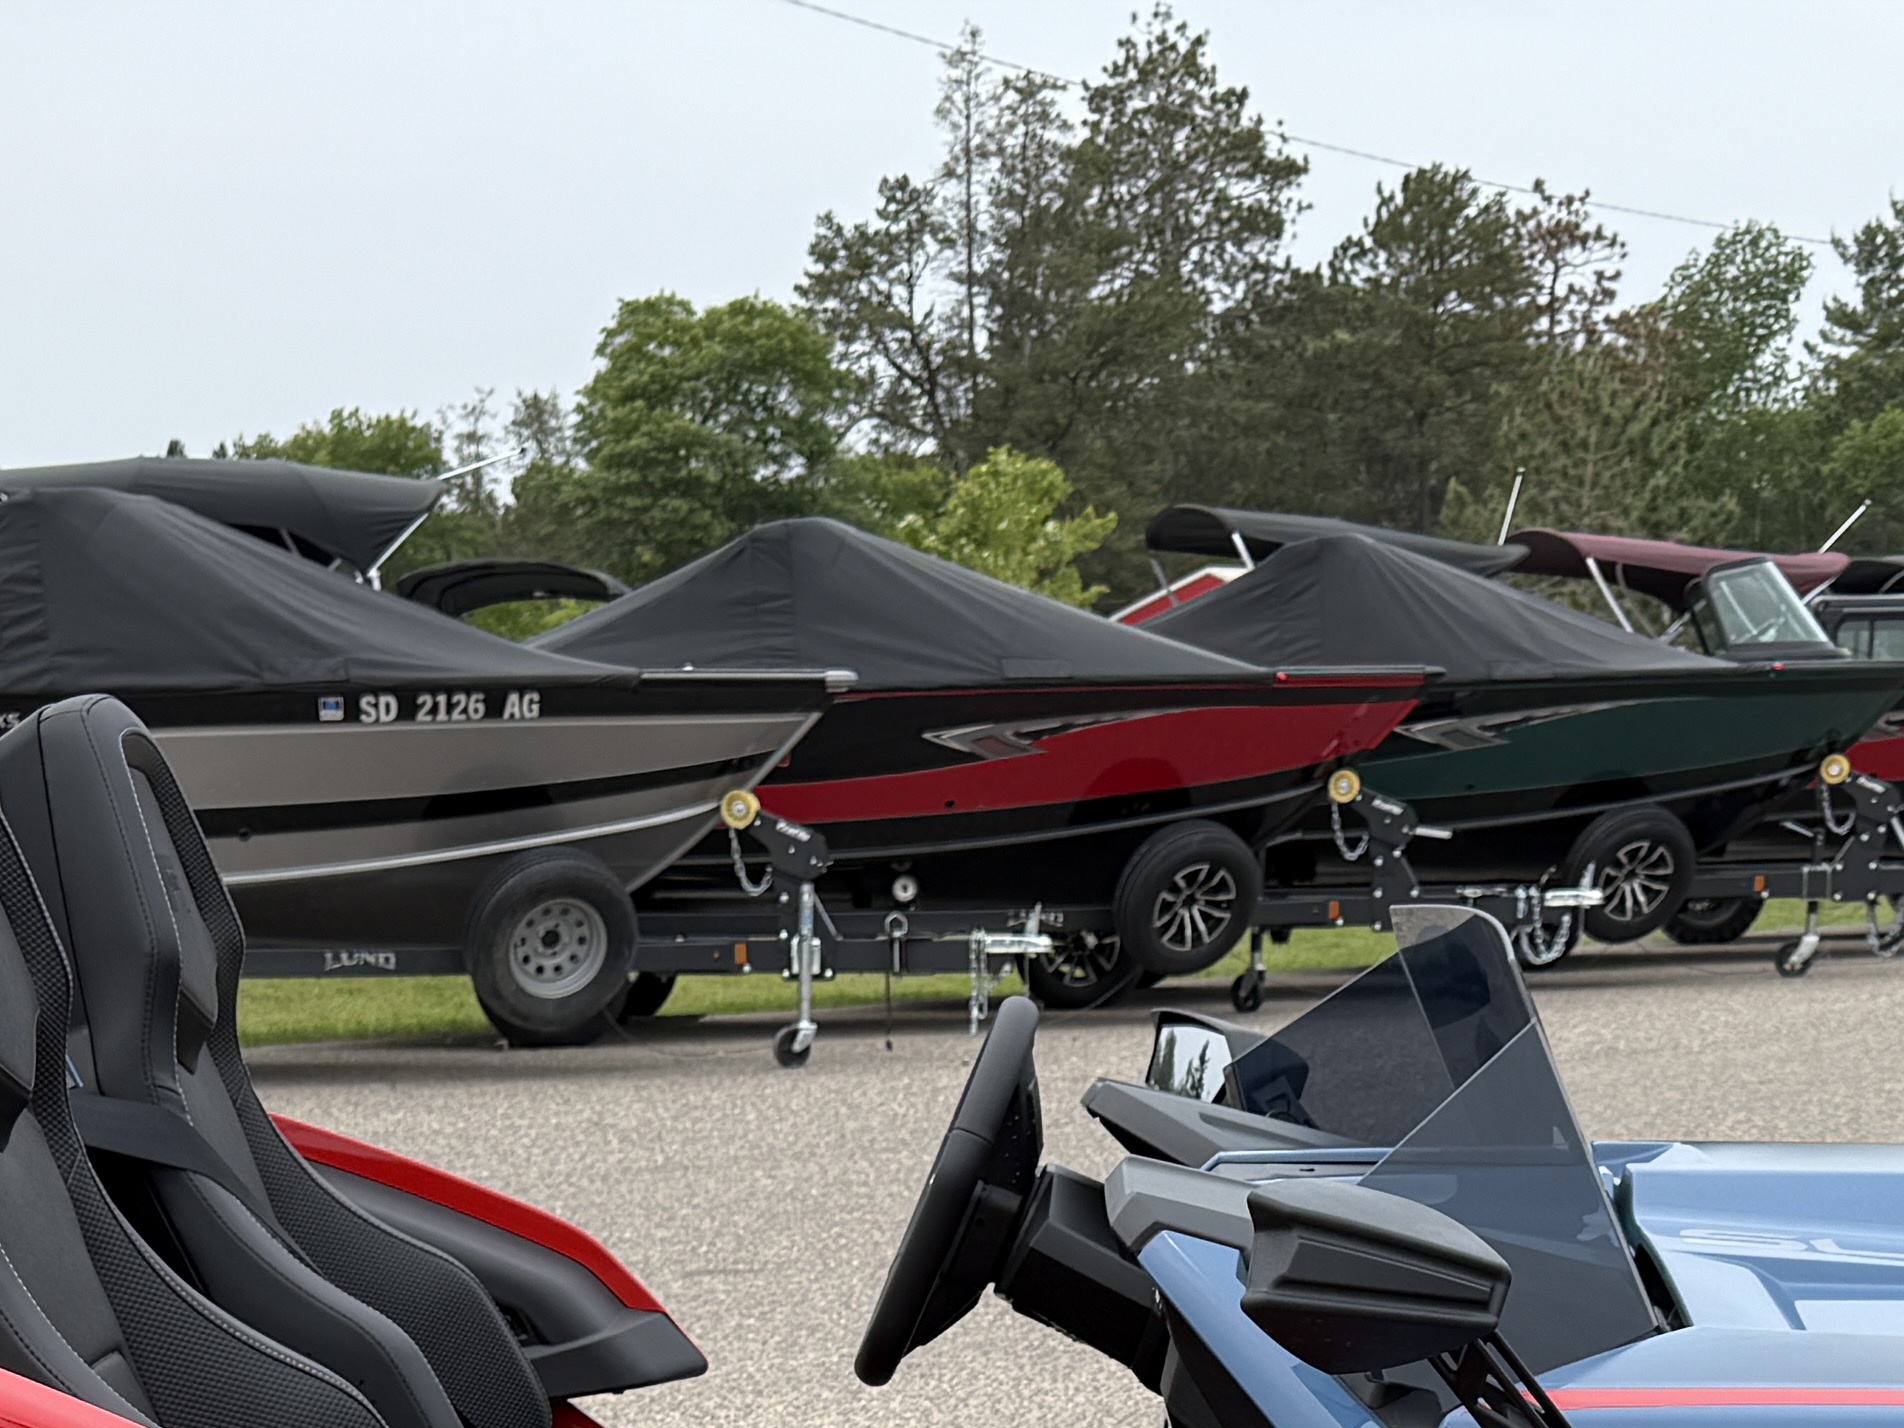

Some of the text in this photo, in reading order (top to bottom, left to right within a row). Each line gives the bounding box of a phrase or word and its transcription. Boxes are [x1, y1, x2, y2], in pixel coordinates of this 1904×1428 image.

[359, 691, 540, 723] SD 2126 AG
[323, 951, 397, 972] LUND
